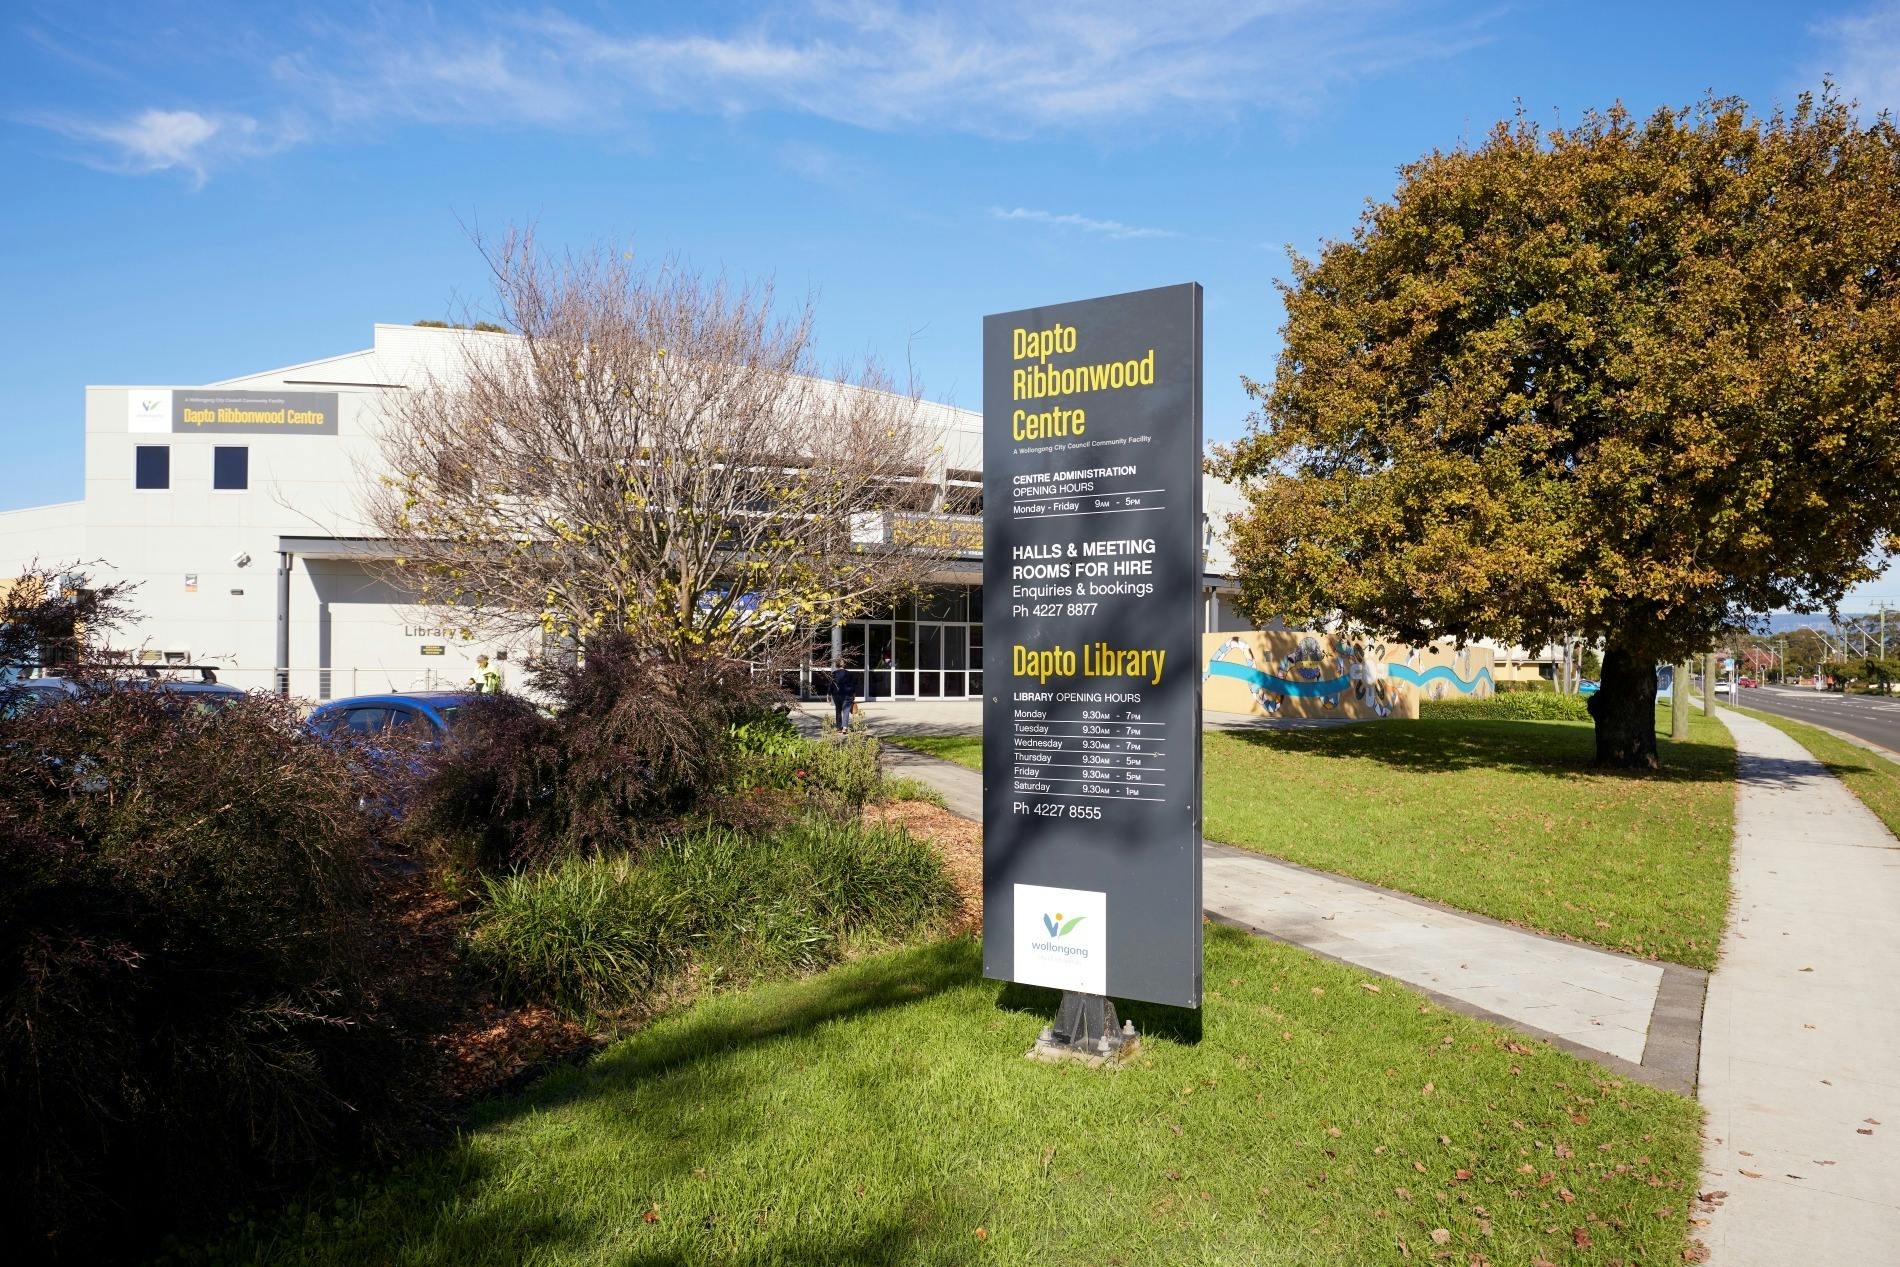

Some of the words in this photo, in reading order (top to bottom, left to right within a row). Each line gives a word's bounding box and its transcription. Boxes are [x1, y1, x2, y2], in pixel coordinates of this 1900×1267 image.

[1013, 323, 1077, 364] Dapto
[1013, 350, 1154, 400] Ribbonwood
[184, 408, 214, 426] Dapto
[217, 408, 285, 424] Ribbonwood
[287, 410, 324, 425] Centre
[1013, 407, 1085, 441] Centre
[1019, 446, 1053, 454] Wollongong
[1091, 438, 1127, 447] Community
[1128, 435, 1152, 443] Facility
[1013, 473, 1050, 485] CENTRE
[1052, 465, 1137, 481] ADMINISTRATION
[1013, 485, 1057, 497] OPENING
[1059, 482, 1094, 493] HOURS
[1013, 504, 1046, 514] Monday
[1053, 502, 1080, 512] Friday
[1094, 500, 1110, 508] 9AM
[1125, 497, 1141, 506] 5PM
[1013, 544, 1062, 560] HALLS
[1066, 543, 1078, 557] &
[1083, 539, 1156, 556] MEETING
[1013, 564, 1070, 580] ROOMS
[1075, 562, 1108, 577] FOR
[1114, 560, 1153, 576] HIRE
[1013, 584, 1072, 600] Enquiries
[1076, 582, 1086, 596] &
[1090, 581, 1154, 597] bookings
[1013, 604, 1029, 617] Ph
[1032, 604, 1063, 617] 4227
[1067, 603, 1098, 616] 8877
[405, 625, 456, 639] Library
[1013, 645, 1076, 685] Dapto
[1084, 642, 1166, 685] Library
[1013, 692, 1054, 702] LIBRARY
[1056, 692, 1102, 703] OPENING
[1105, 693, 1141, 703] HOURS
[1014, 709, 1047, 719] Monday
[1082, 711, 1110, 720] 9.30AM
[1126, 711, 1142, 721] 7PM
[1014, 724, 1049, 734] Tuesday
[1082, 726, 1110, 735] 9.30AM
[1126, 726, 1142, 736] 7PM
[1014, 739, 1063, 749] Wednesday
[1082, 740, 1110, 750] 9.30AM
[1126, 741, 1142, 750] 7PM
[1014, 752, 1052, 763] Thursday
[1082, 755, 1110, 765] 9.30AM
[1126, 757, 1142, 766] 5PM
[1014, 767, 1040, 777] Friday
[1082, 770, 1110, 780] 9.30AM
[1126, 771, 1142, 781] 5PM
[1014, 781, 1051, 792] Saturday
[1082, 785, 1110, 794] 9.30AM
[1126, 787, 1139, 796] 1PM
[1013, 802, 1030, 815] Ph
[1033, 804, 1066, 817] 4227
[1069, 806, 1102, 820] 8555
[1031, 942, 1088, 958] wollongong
